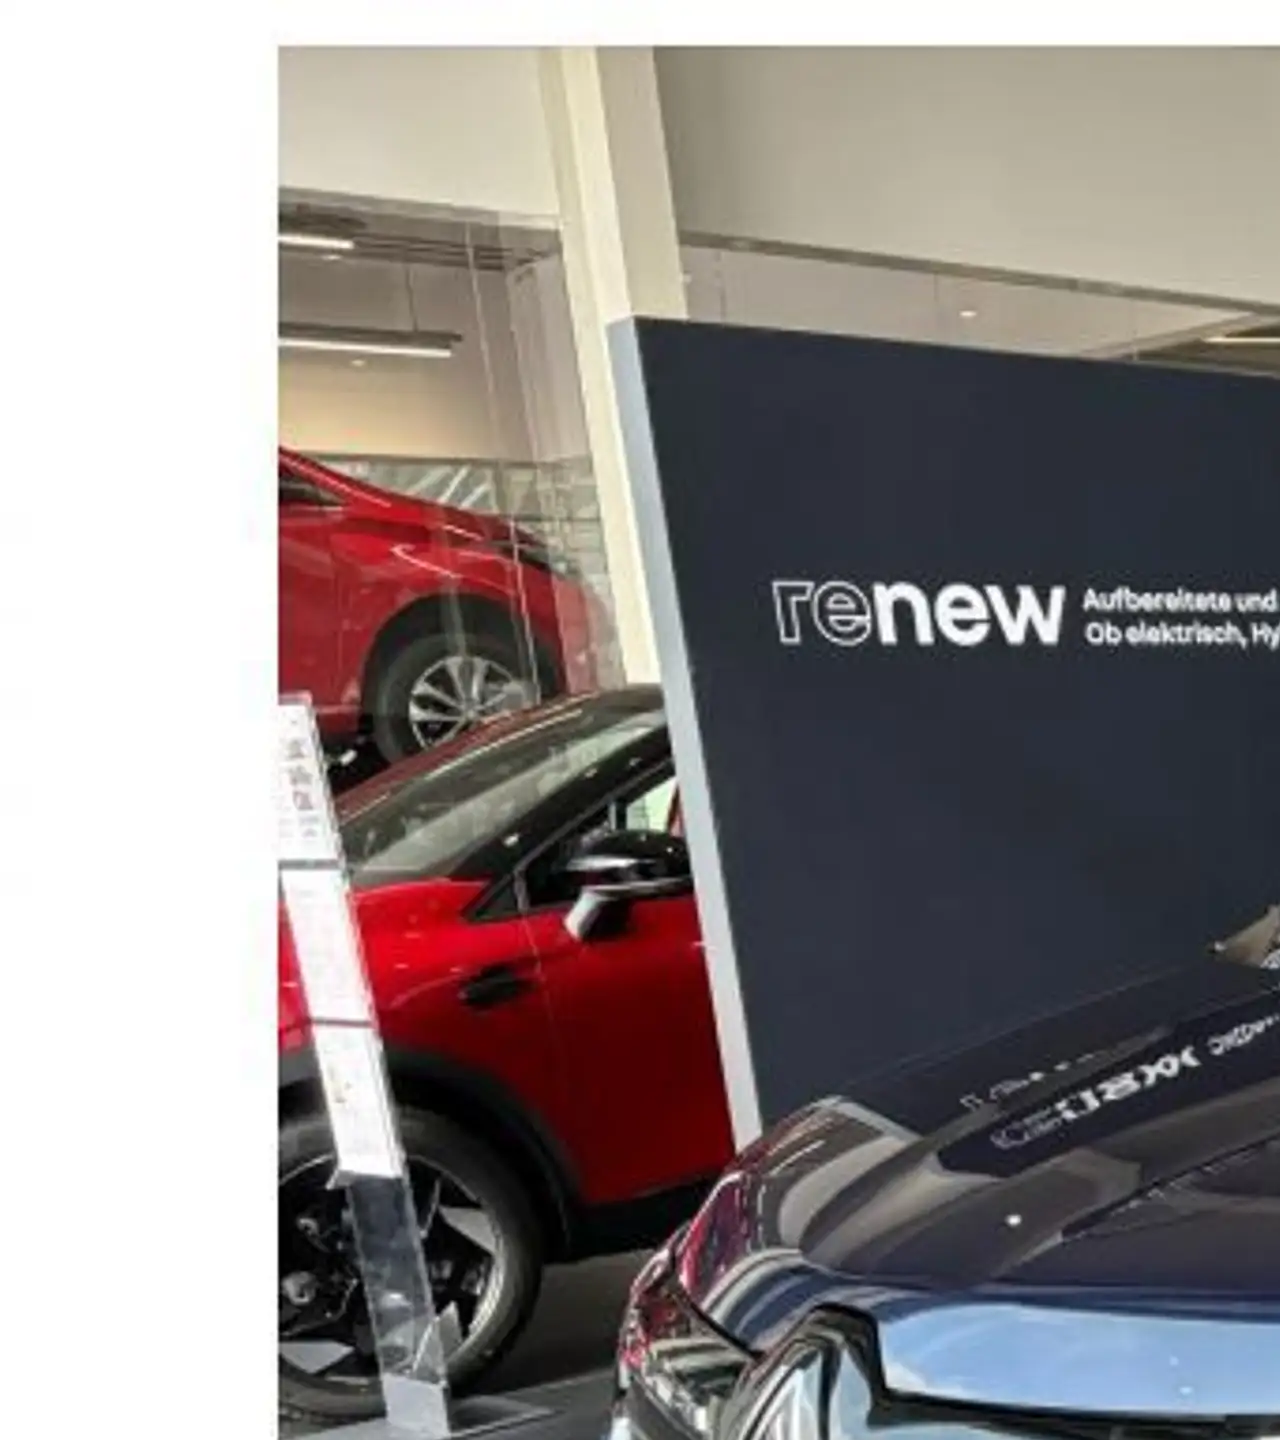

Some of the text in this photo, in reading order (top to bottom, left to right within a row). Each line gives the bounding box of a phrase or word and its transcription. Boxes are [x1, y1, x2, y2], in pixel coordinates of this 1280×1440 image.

[771, 579, 1067, 647] renew
[1082, 585, 1232, 613] Aufbereitete
[1235, 587, 1278, 613] und
[1085, 620, 1122, 646] Ob
[1125, 620, 1248, 650] elektrisch,
